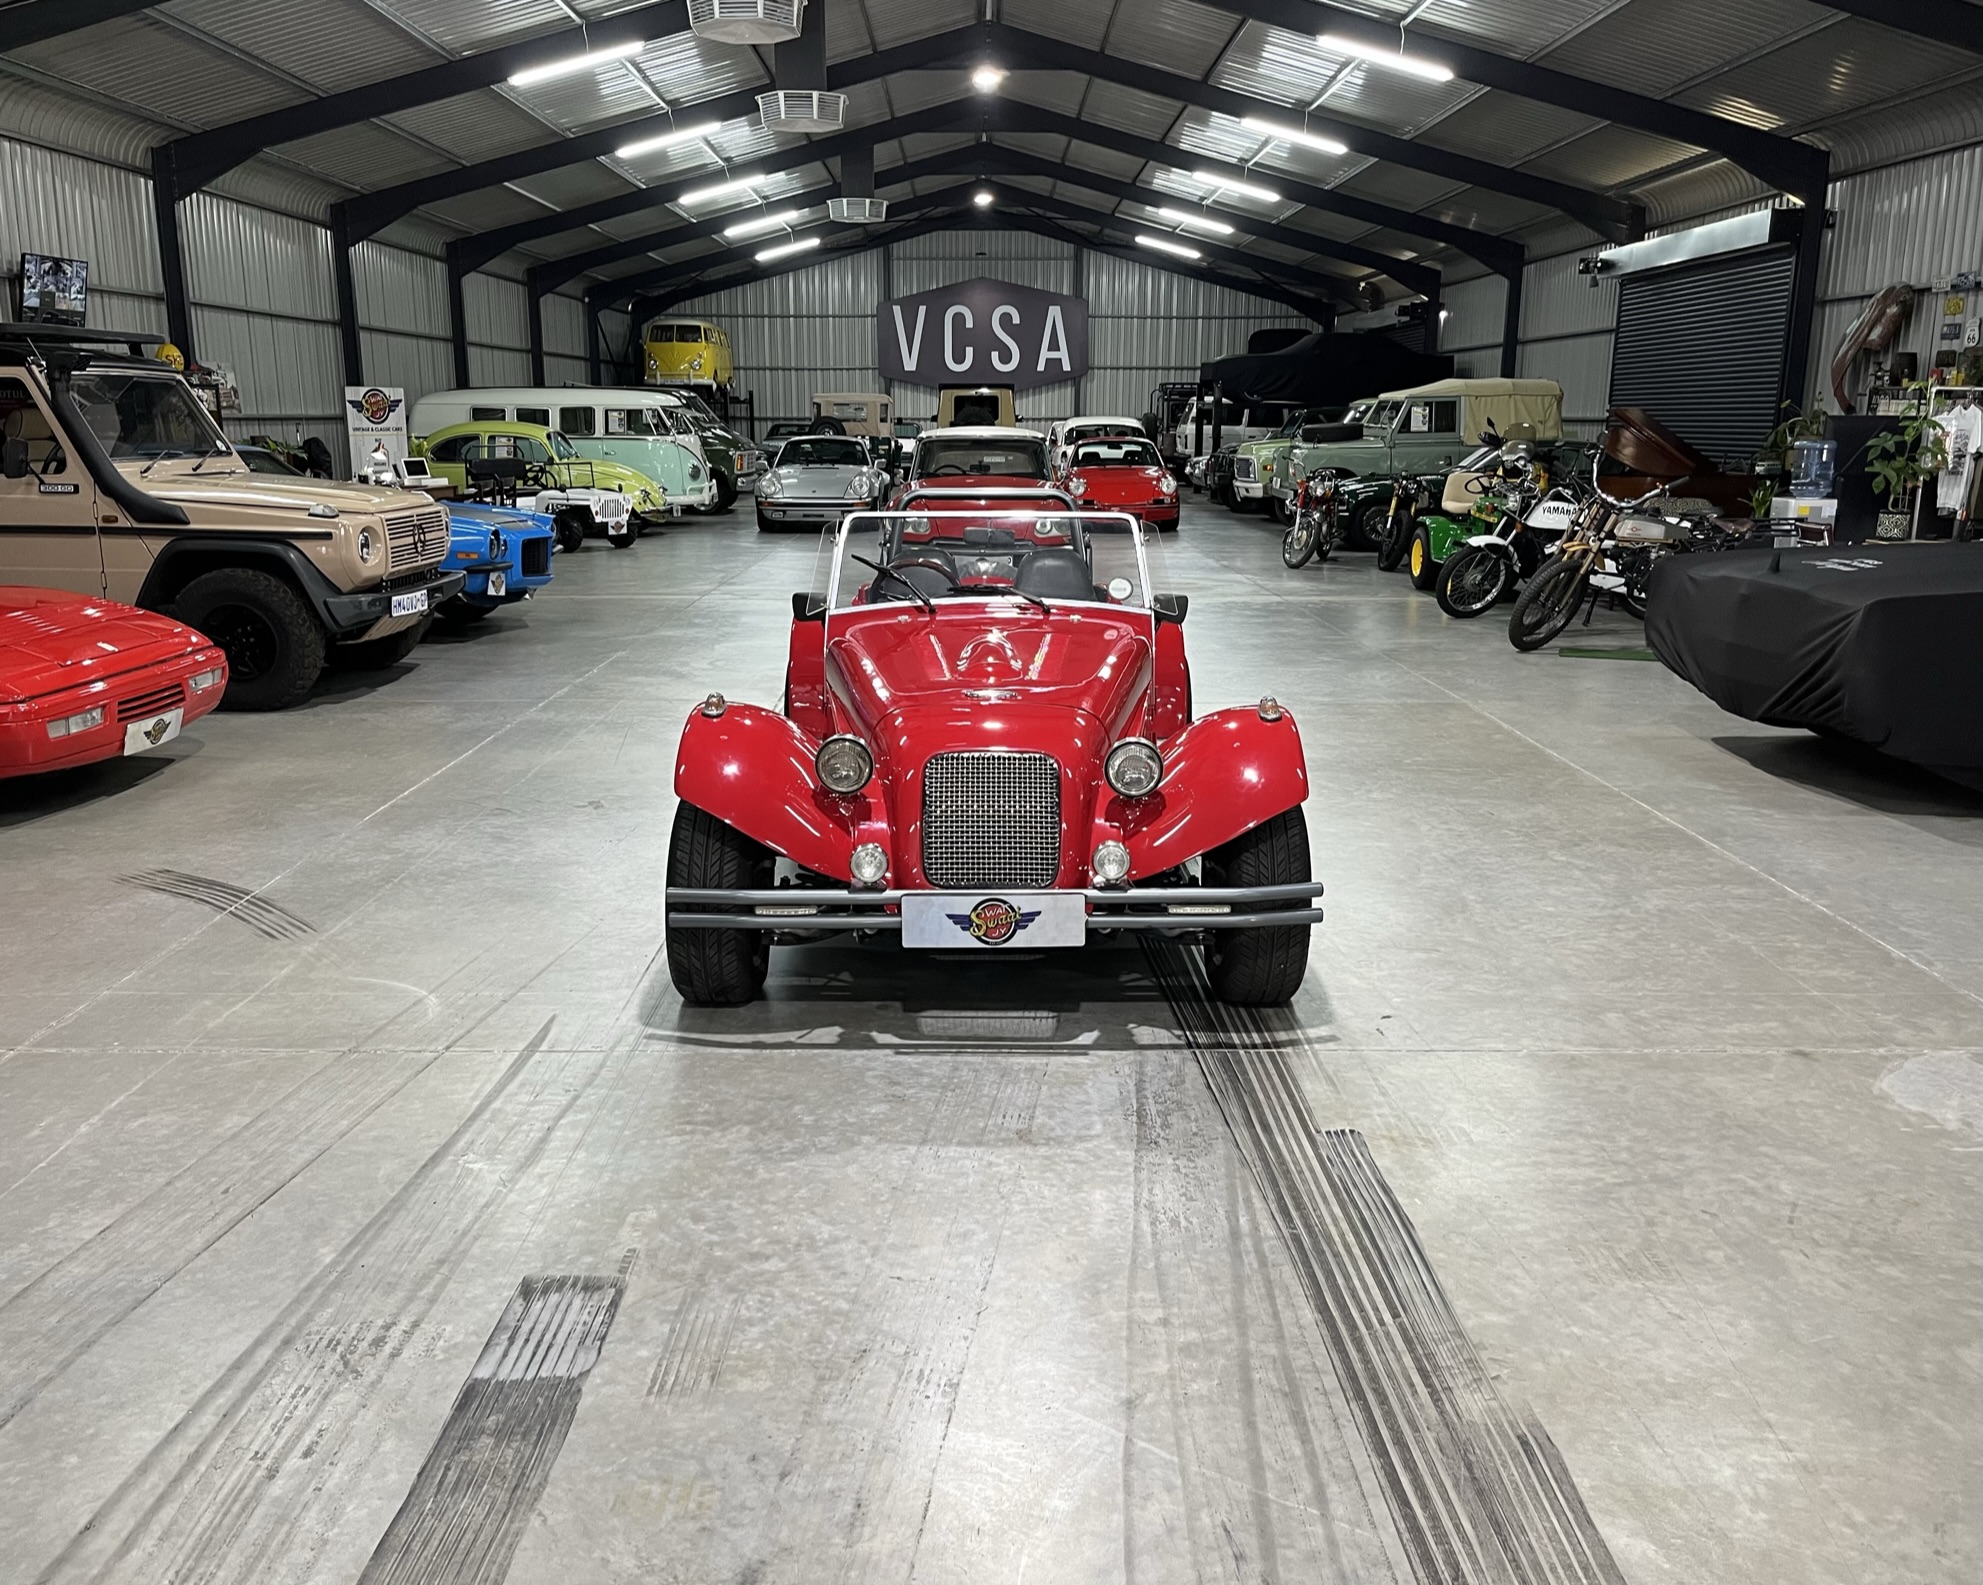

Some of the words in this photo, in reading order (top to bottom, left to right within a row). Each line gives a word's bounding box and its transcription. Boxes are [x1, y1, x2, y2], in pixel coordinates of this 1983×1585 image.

[892, 304, 1071, 372] VCSA
[1966, 333, 1976, 344] 66
[1542, 506, 1577, 516] YAMAHA
[985, 904, 1010, 917] WAT
[970, 905, 1021, 936] Swaai
[992, 928, 1006, 936] JY
